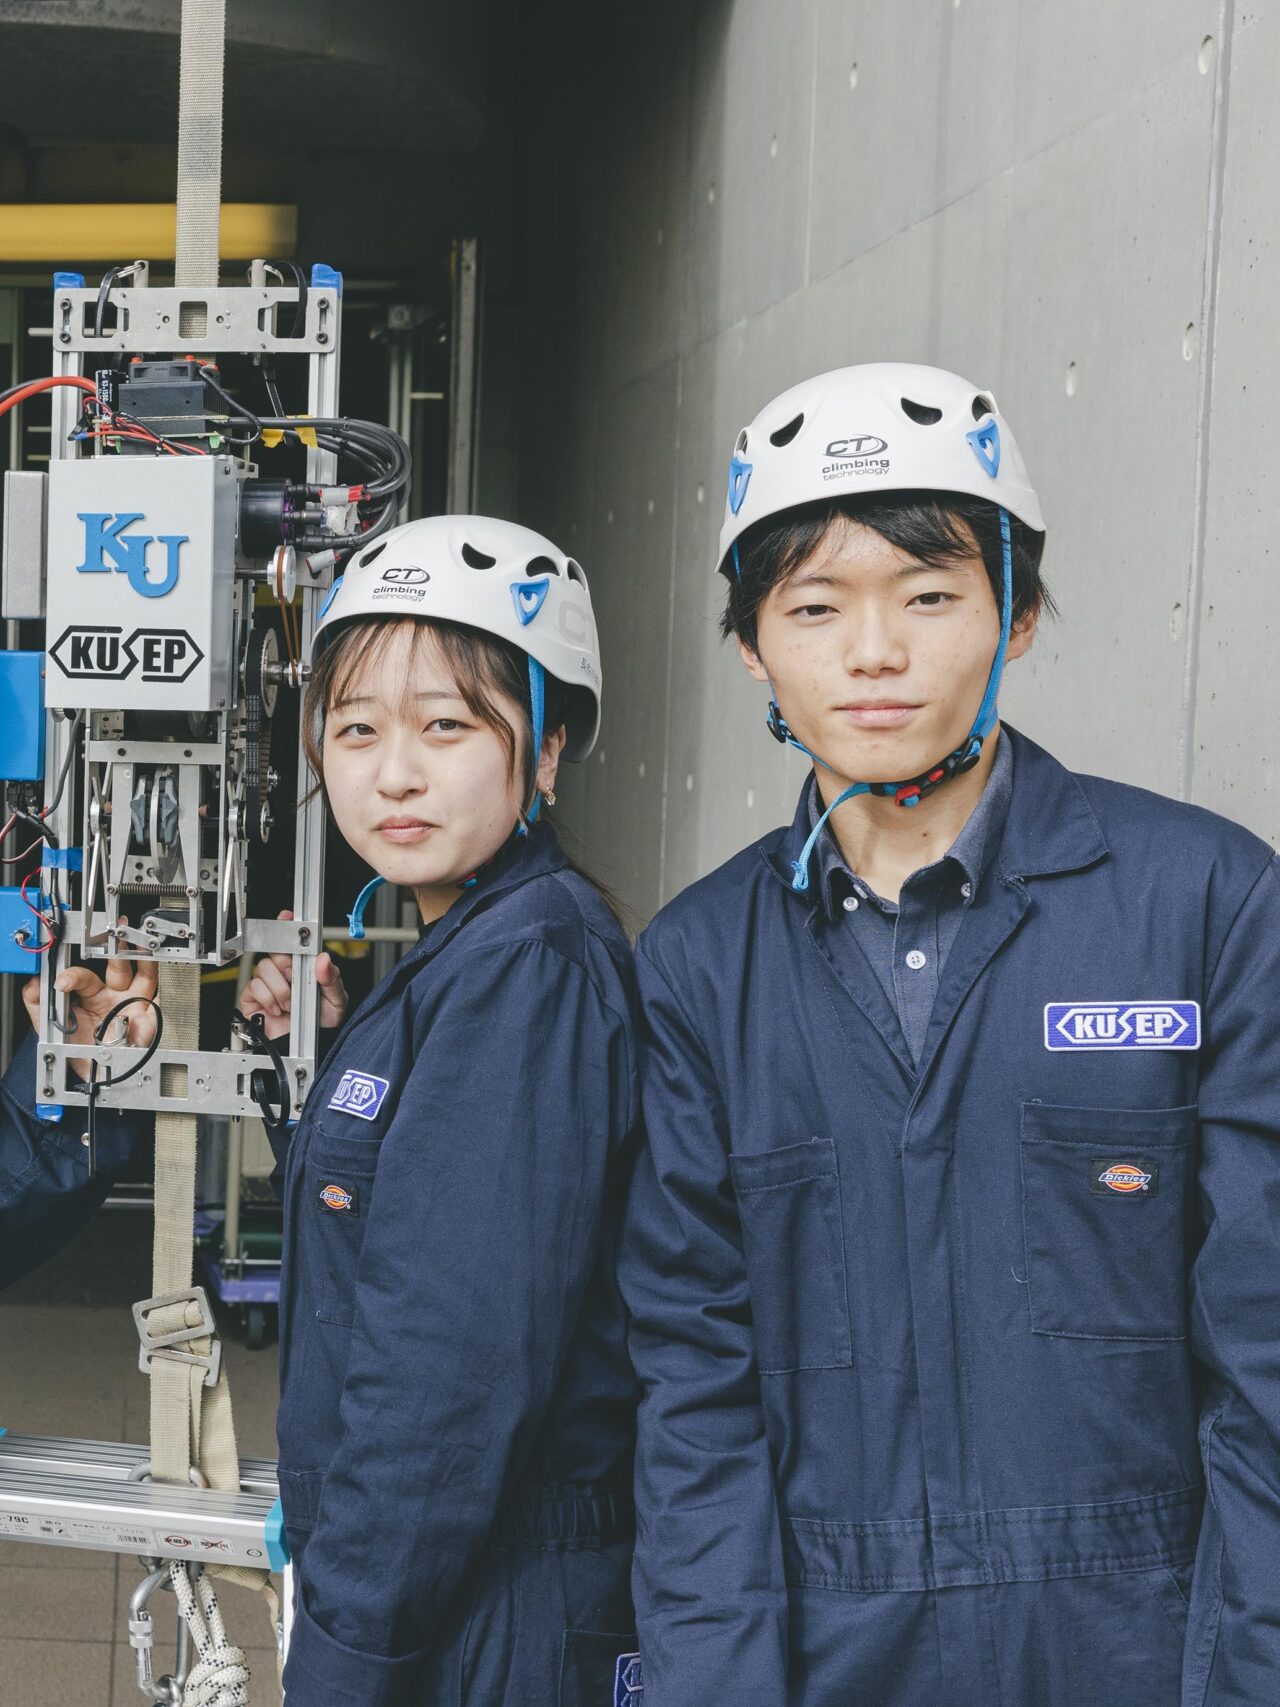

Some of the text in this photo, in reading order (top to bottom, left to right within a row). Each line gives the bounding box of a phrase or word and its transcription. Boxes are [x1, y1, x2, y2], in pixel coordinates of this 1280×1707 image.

[825, 436, 873, 456] CT
[822, 459, 890, 474] climbing
[823, 467, 890, 481] technology
[76, 513, 188, 598] KU
[382, 567, 422, 581] CT
[372, 593, 425, 602] technology
[373, 586, 426, 597] climbing
[69, 626, 187, 683] KUSEP
[1073, 1008, 1174, 1043] KUSEP
[1104, 1173, 1148, 1183] Dickies
